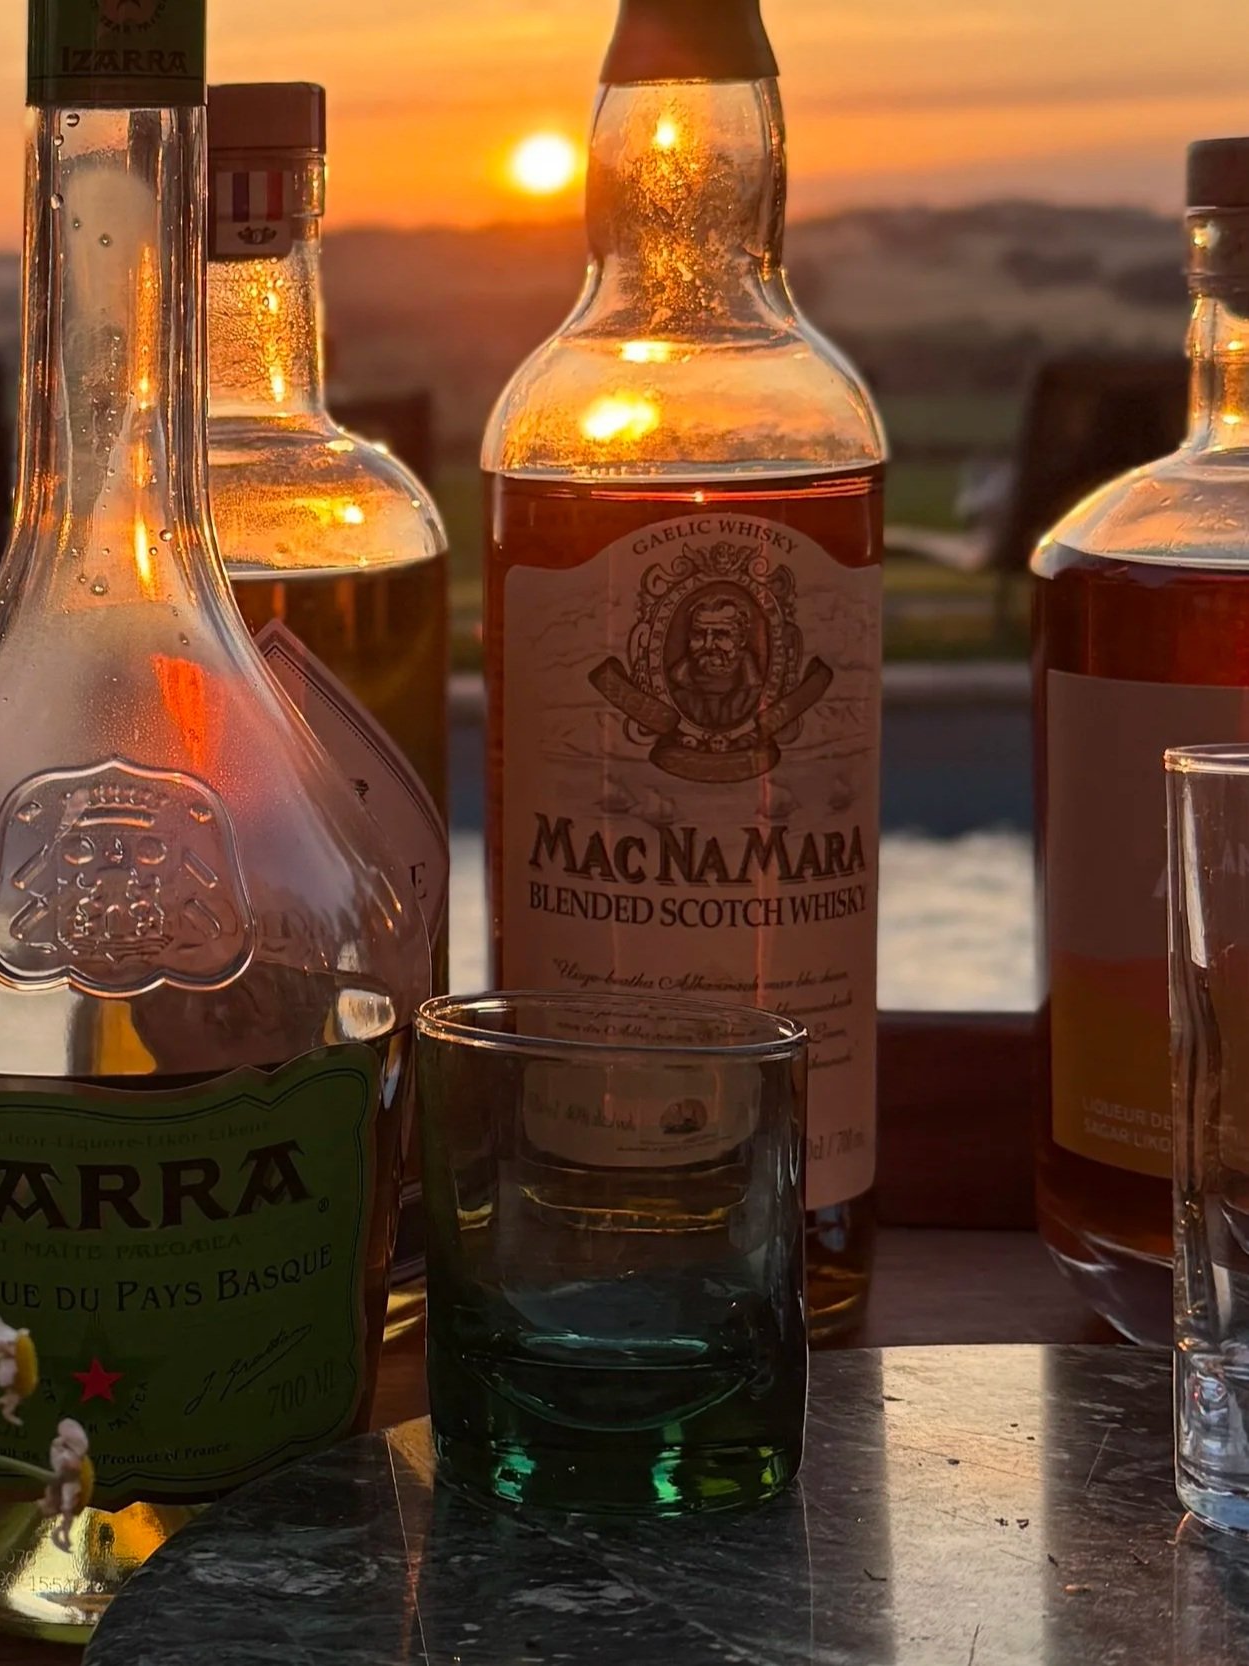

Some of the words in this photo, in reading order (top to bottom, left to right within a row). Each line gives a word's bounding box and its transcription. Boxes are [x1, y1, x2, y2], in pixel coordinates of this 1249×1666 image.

[60, 45, 188, 74] IZARRA
[632, 519, 712, 556] GAELIC
[717, 519, 799, 555] WHISKY
[529, 880, 654, 925] BLENDED
[660, 896, 783, 928] SCOTCH
[789, 883, 868, 924] WHISKY
[1082, 1095, 1147, 1126] LIQUEUR
[1134, 1130, 1173, 1153] LIKO
[54, 1285, 101, 1313] DU
[117, 1279, 203, 1312] PAYS
[215, 1243, 333, 1303] BASQUE
[266, 1375, 307, 1420] 700
